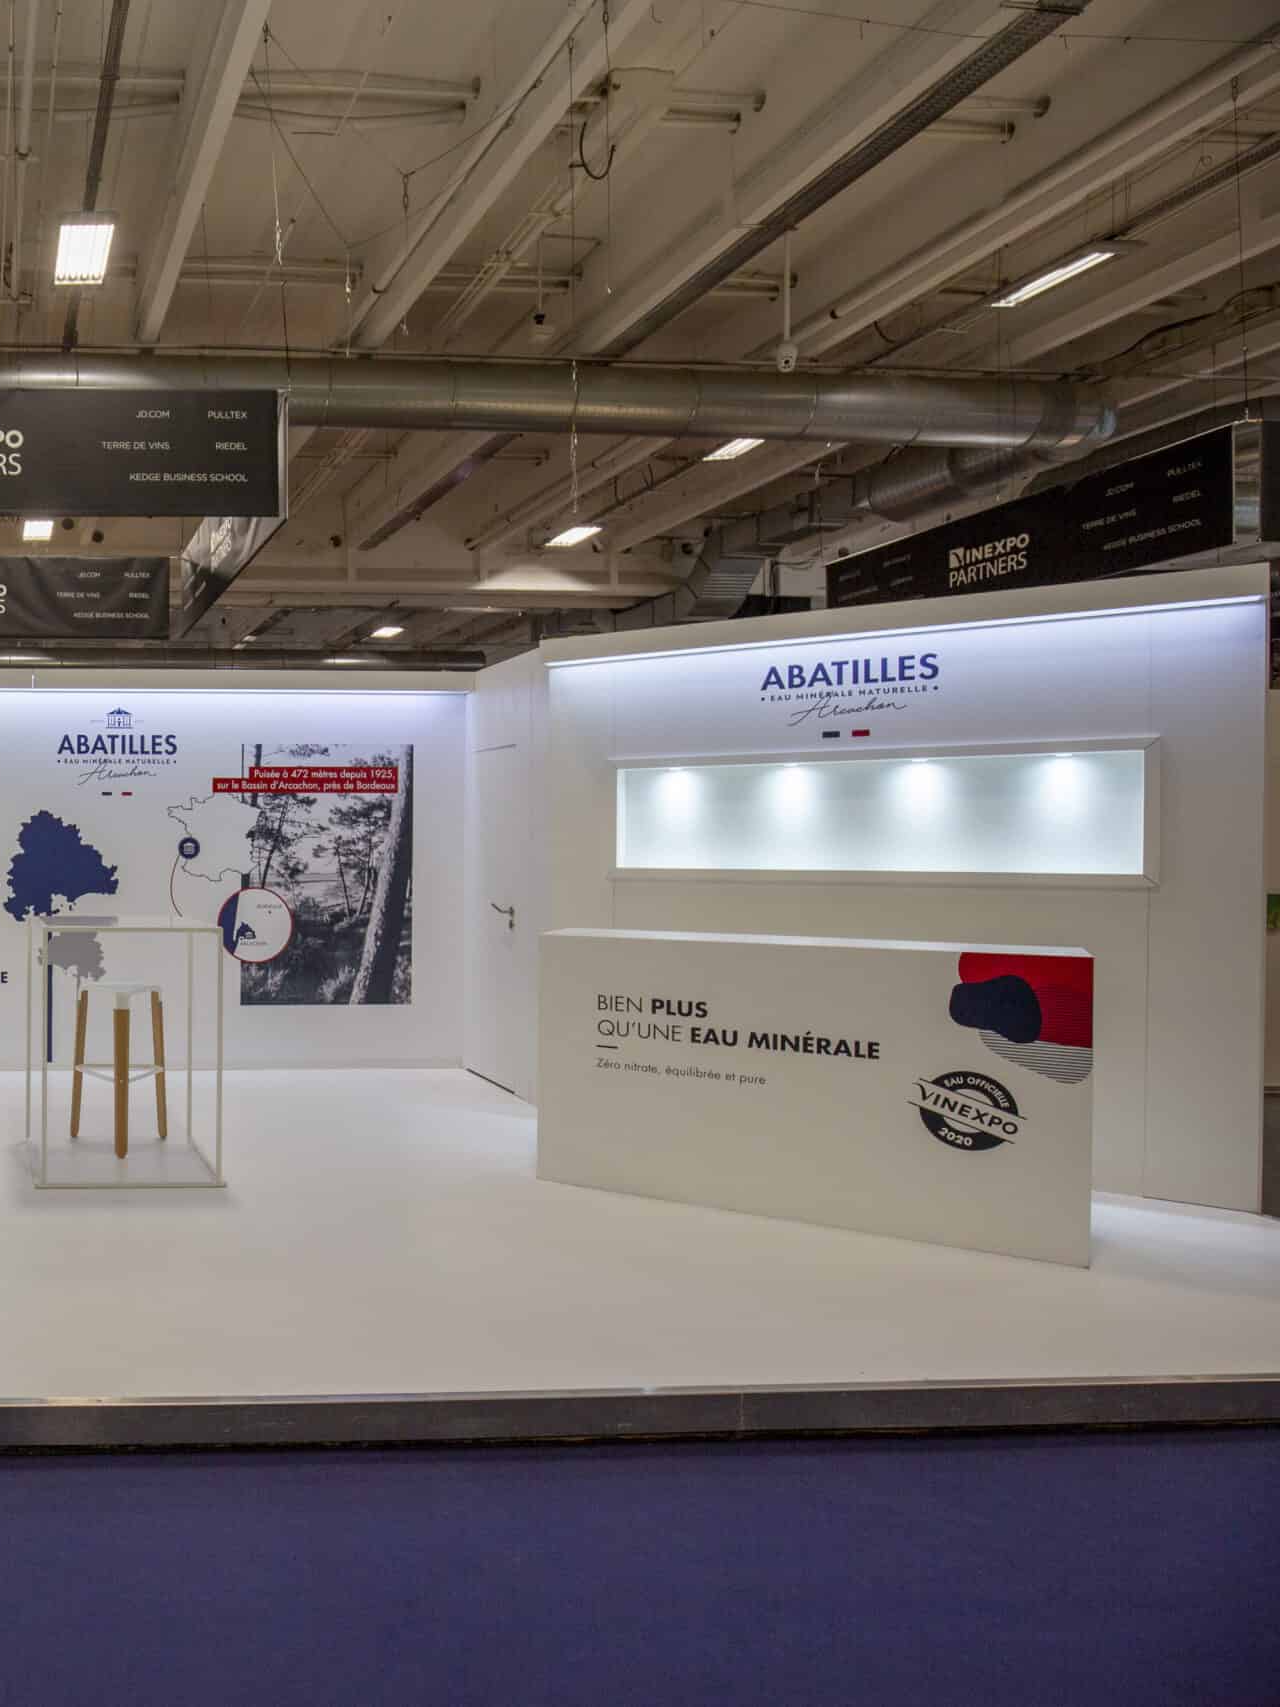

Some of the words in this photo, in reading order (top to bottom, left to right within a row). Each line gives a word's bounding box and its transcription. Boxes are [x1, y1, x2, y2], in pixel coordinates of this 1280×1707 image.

[135, 410, 170, 419] JD.COM
[207, 410, 248, 419] PULLTEX
[102, 441, 131, 450] TERRE
[133, 441, 145, 450] DE
[147, 441, 171, 450] VINS
[215, 441, 248, 450] RIEDEL
[129, 472, 161, 482] KEDGE
[163, 473, 208, 482] BUSINESS
[209, 473, 248, 482] SCHOOL
[949, 552, 1028, 588] PARTNERS
[761, 653, 939, 691] ABATILLES
[770, 694, 791, 702] EAU
[859, 685, 928, 697] NATURELLE
[57, 734, 178, 755] ABATILLES
[254, 769, 280, 778] Puisée
[291, 769, 309, 778] 472
[311, 769, 338, 778] mètres
[340, 769, 367, 780] depuis
[216, 782, 229, 790] sur
[231, 780, 239, 790] le
[241, 781, 268, 790] Bassin
[270, 780, 321, 792] d'Arcachon,
[323, 781, 340, 792] près
[343, 780, 354, 790] de
[356, 780, 396, 790] Bordeaux
[597, 994, 643, 1013] BIEN
[650, 998, 709, 1019] PLUS
[597, 1018, 682, 1042] QU'UNE
[690, 1026, 739, 1048] EAU
[747, 1031, 881, 1060] MINÉRALE
[596, 1057, 621, 1070] Zéro
[624, 1061, 661, 1075] nitrate,
[665, 1065, 721, 1081] équilibrée
[725, 1072, 736, 1082] et
[944, 1076, 964, 1088] EAU
[912, 1082, 1018, 1135] VINEXPO
[938, 1127, 973, 1147] 2020
